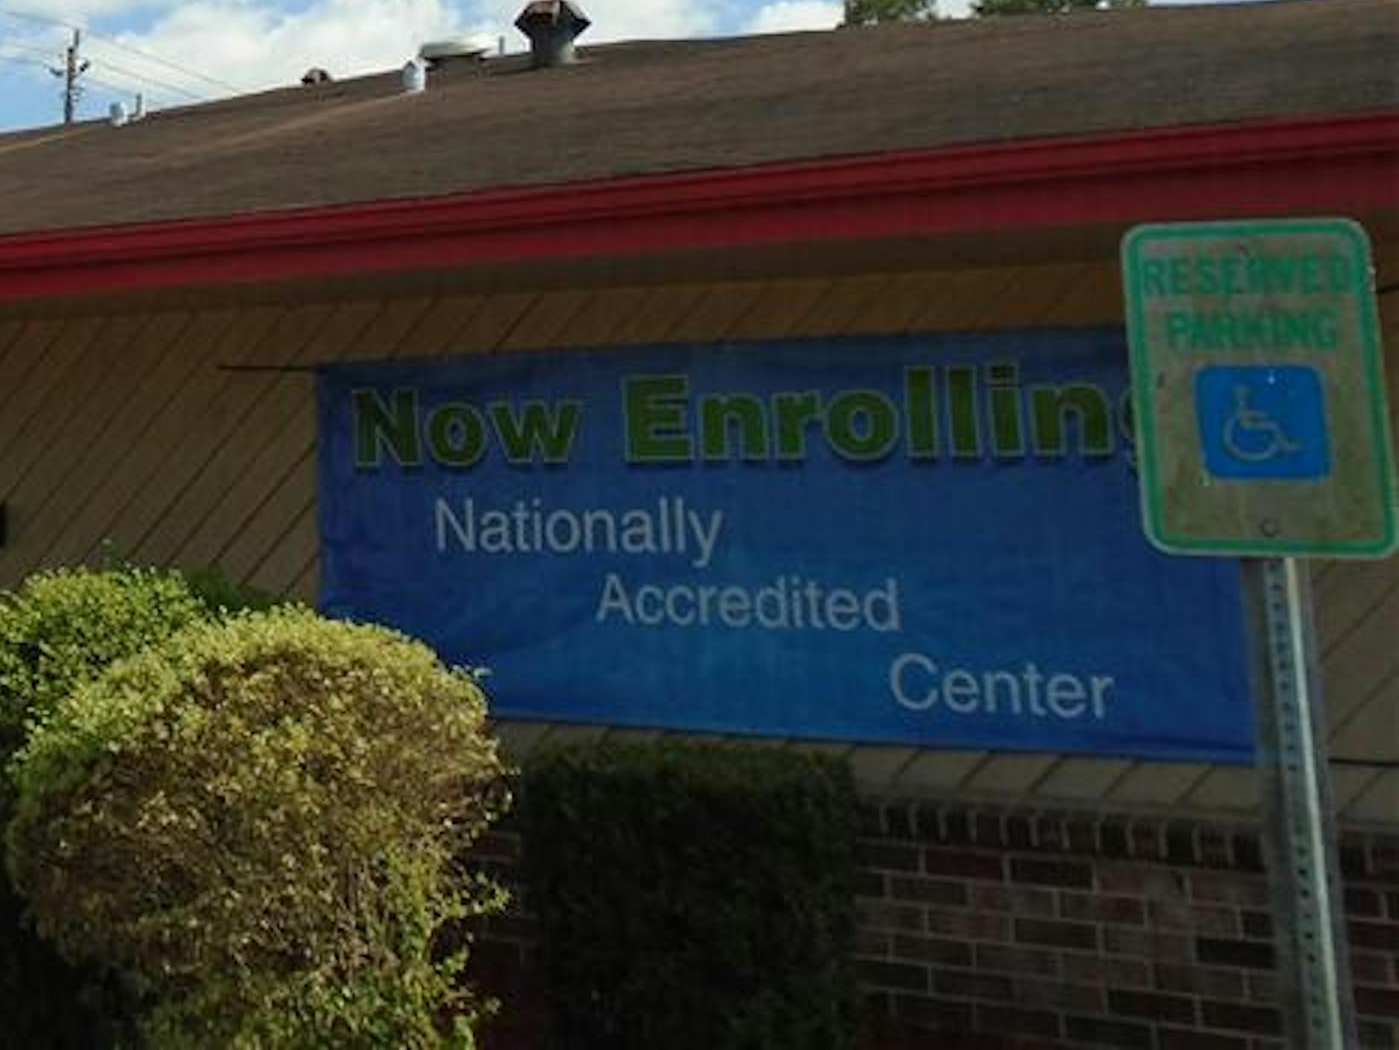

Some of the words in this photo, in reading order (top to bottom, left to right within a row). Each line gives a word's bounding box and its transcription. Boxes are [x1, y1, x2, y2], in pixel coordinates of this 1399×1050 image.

[1166, 305, 1338, 348] PARKING
[351, 388, 582, 469] Now
[622, 363, 1140, 468] Enrollin
[433, 496, 724, 568] Nationally
[595, 572, 901, 631] Accredited
[888, 652, 1114, 718] Center
